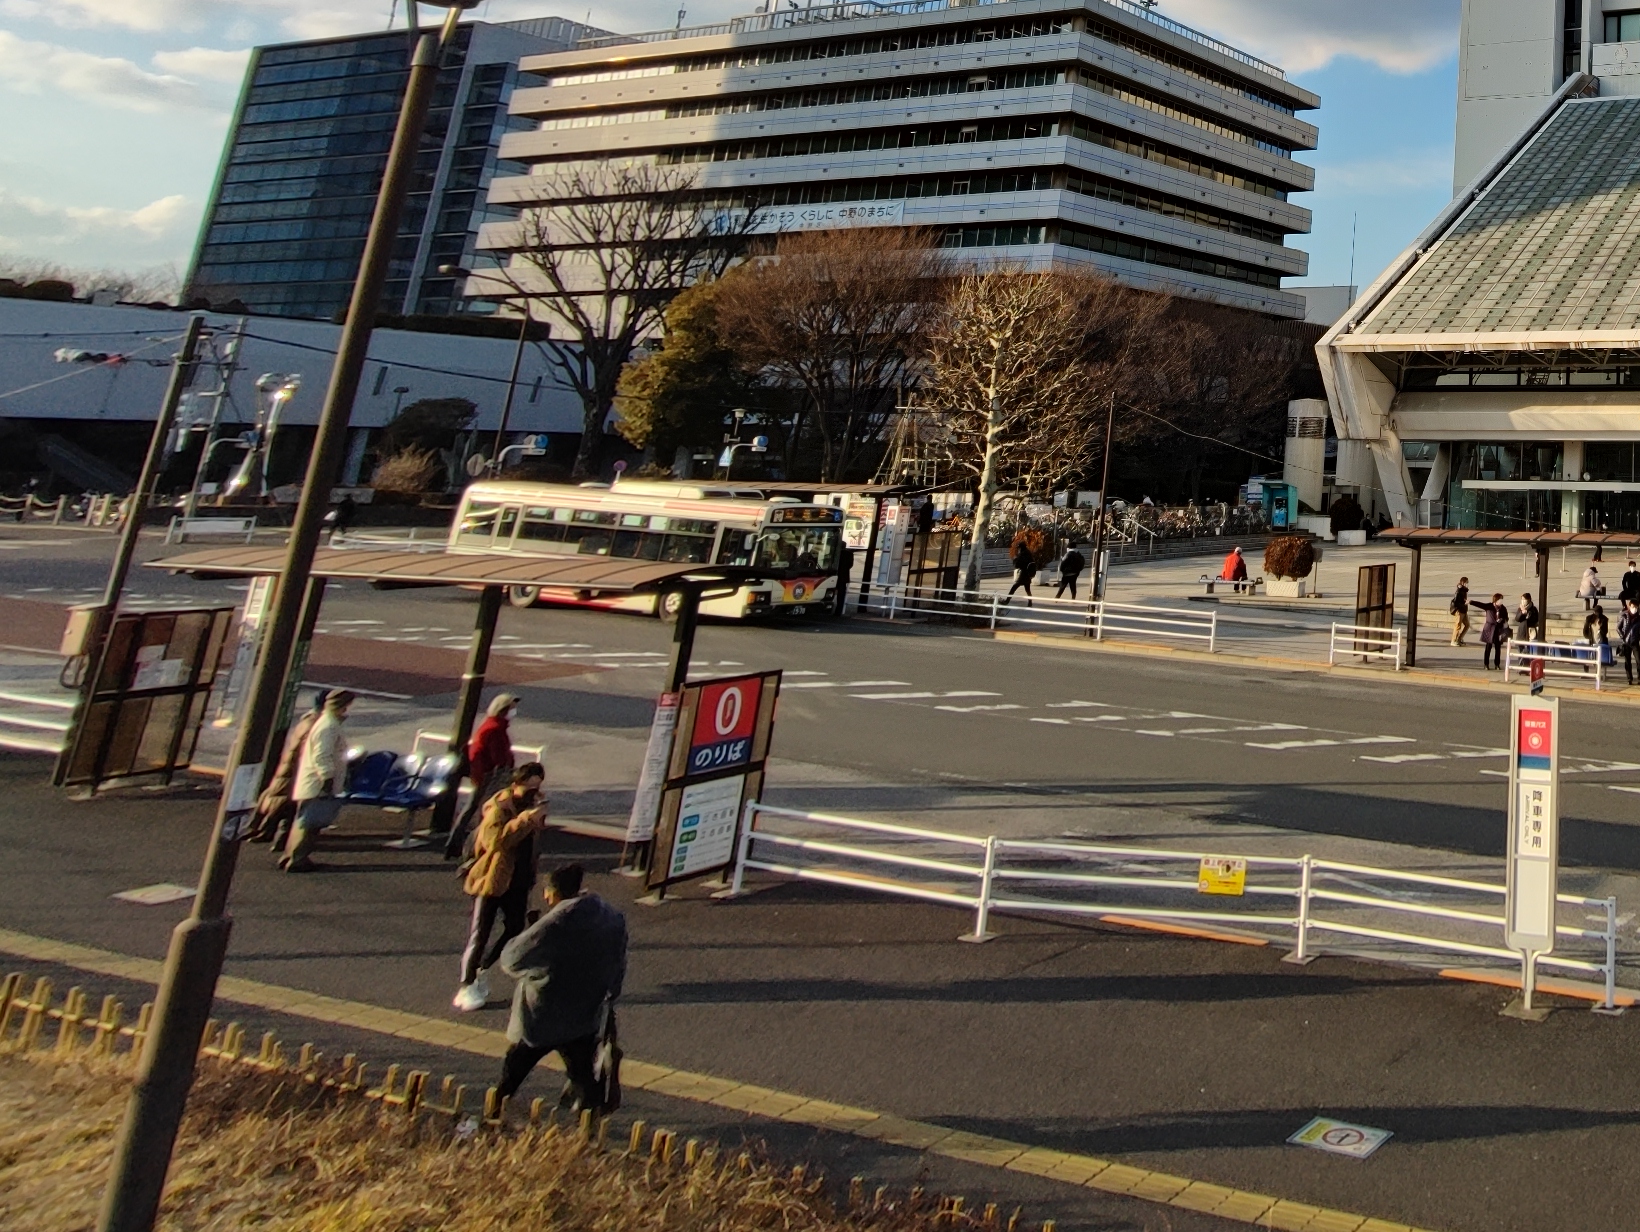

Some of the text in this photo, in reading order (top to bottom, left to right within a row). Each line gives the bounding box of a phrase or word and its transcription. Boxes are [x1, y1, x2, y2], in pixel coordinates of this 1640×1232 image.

[800, 209, 833, 221] くらしに
[839, 205, 894, 219] 中野のまちに
[715, 686, 742, 735] 0
[695, 739, 746, 767] のりば
[1532, 790, 1543, 848] 降車専用
